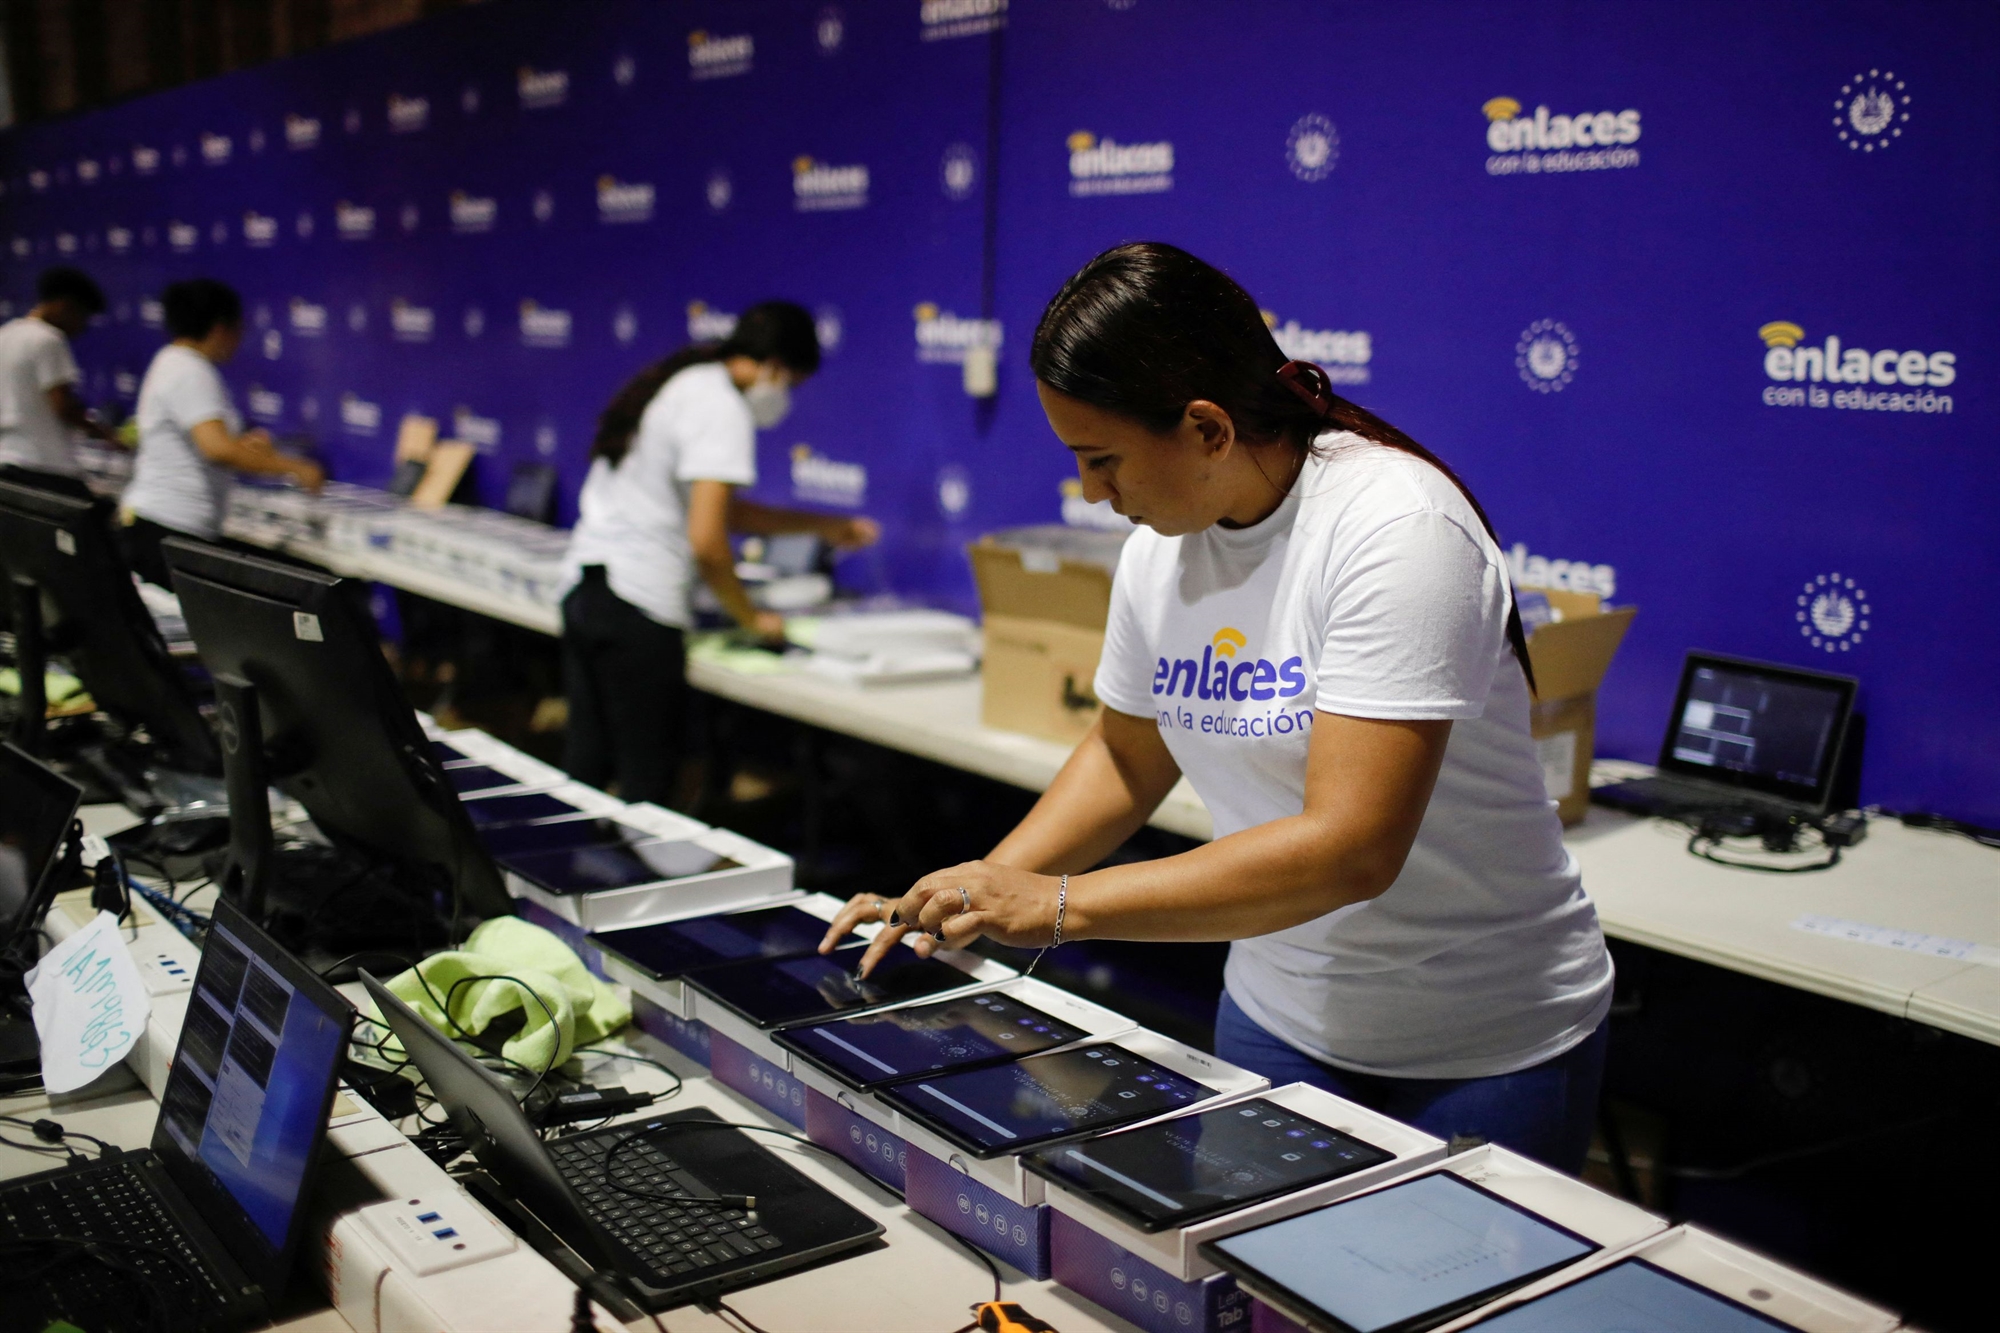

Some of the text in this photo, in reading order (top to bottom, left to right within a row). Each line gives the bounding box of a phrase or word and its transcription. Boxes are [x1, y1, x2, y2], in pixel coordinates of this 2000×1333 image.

[1486, 104, 1641, 153] enlaces
[1271, 320, 1371, 365] nlaces
[1764, 335, 1957, 387] enlaces
[1762, 384, 1953, 414] con la educación
[1152, 645, 1306, 702] enlaces
[1177, 706, 1193, 730] la
[1201, 707, 1314, 737] educación
[1217, 1307, 1243, 1328] Tab
